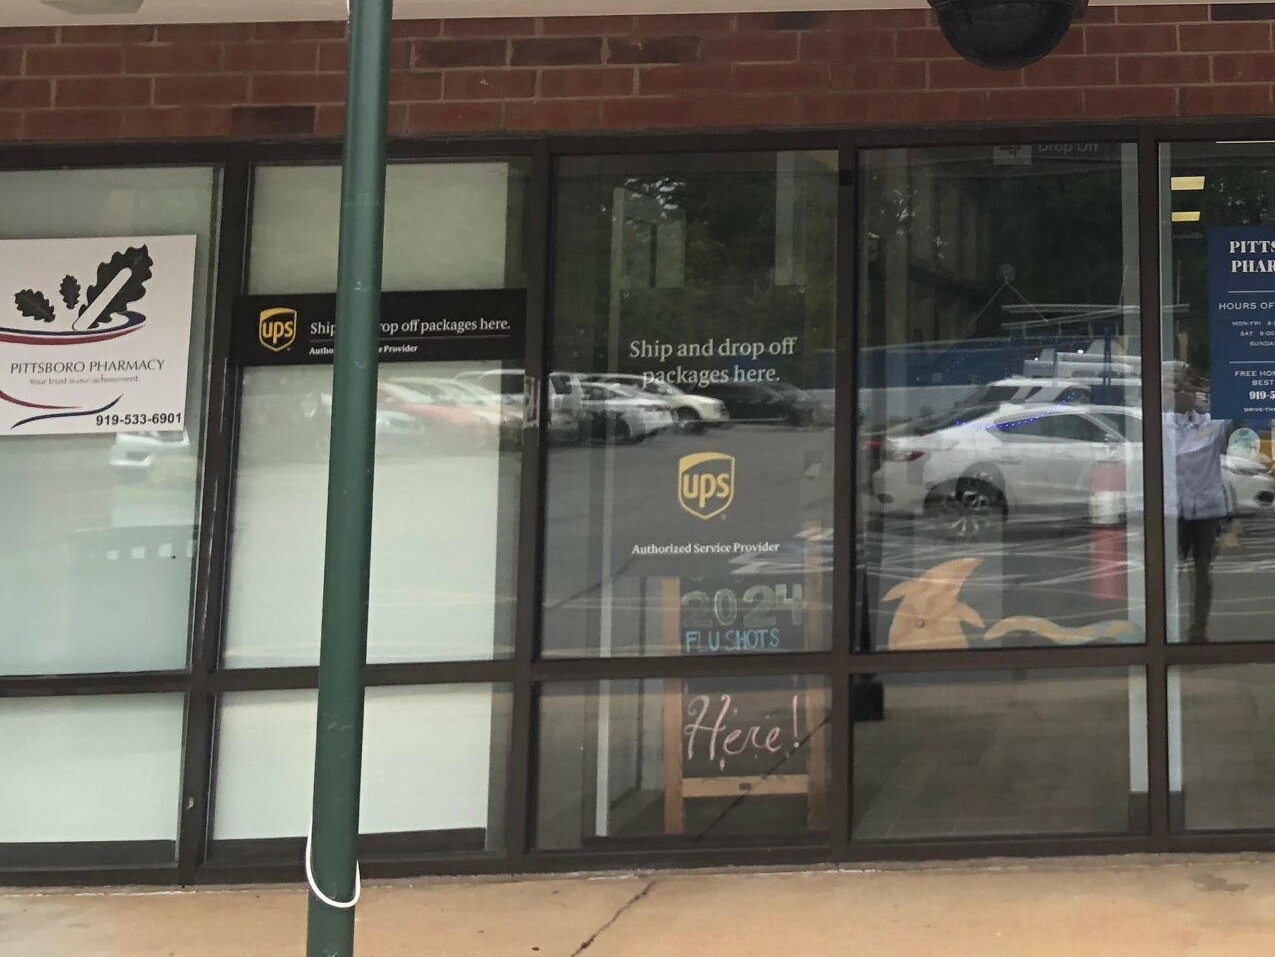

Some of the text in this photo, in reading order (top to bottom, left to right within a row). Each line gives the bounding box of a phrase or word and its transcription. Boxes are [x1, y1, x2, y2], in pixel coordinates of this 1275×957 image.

[1218, 302, 1257, 310] HOURS
[262, 321, 293, 344] ups
[310, 321, 335, 336] Ship
[401, 319, 420, 332] off
[420, 319, 478, 335] packages
[480, 317, 511, 331] here.
[383, 344, 418, 353] Provider
[629, 337, 798, 362] Ship and drop off
[10, 359, 166, 374] PITTSBORO PHARMACY
[642, 365, 781, 388] packages here.
[48, 377, 67, 385] trust
[95, 413, 182, 426] 919-533-6901
[683, 473, 730, 508] ups
[631, 542, 780, 555] Authorized Service Provider
[680, 583, 806, 628] 2024
[685, 628, 781, 653] FLU SHOTS
[684, 694, 799, 762] Here!
